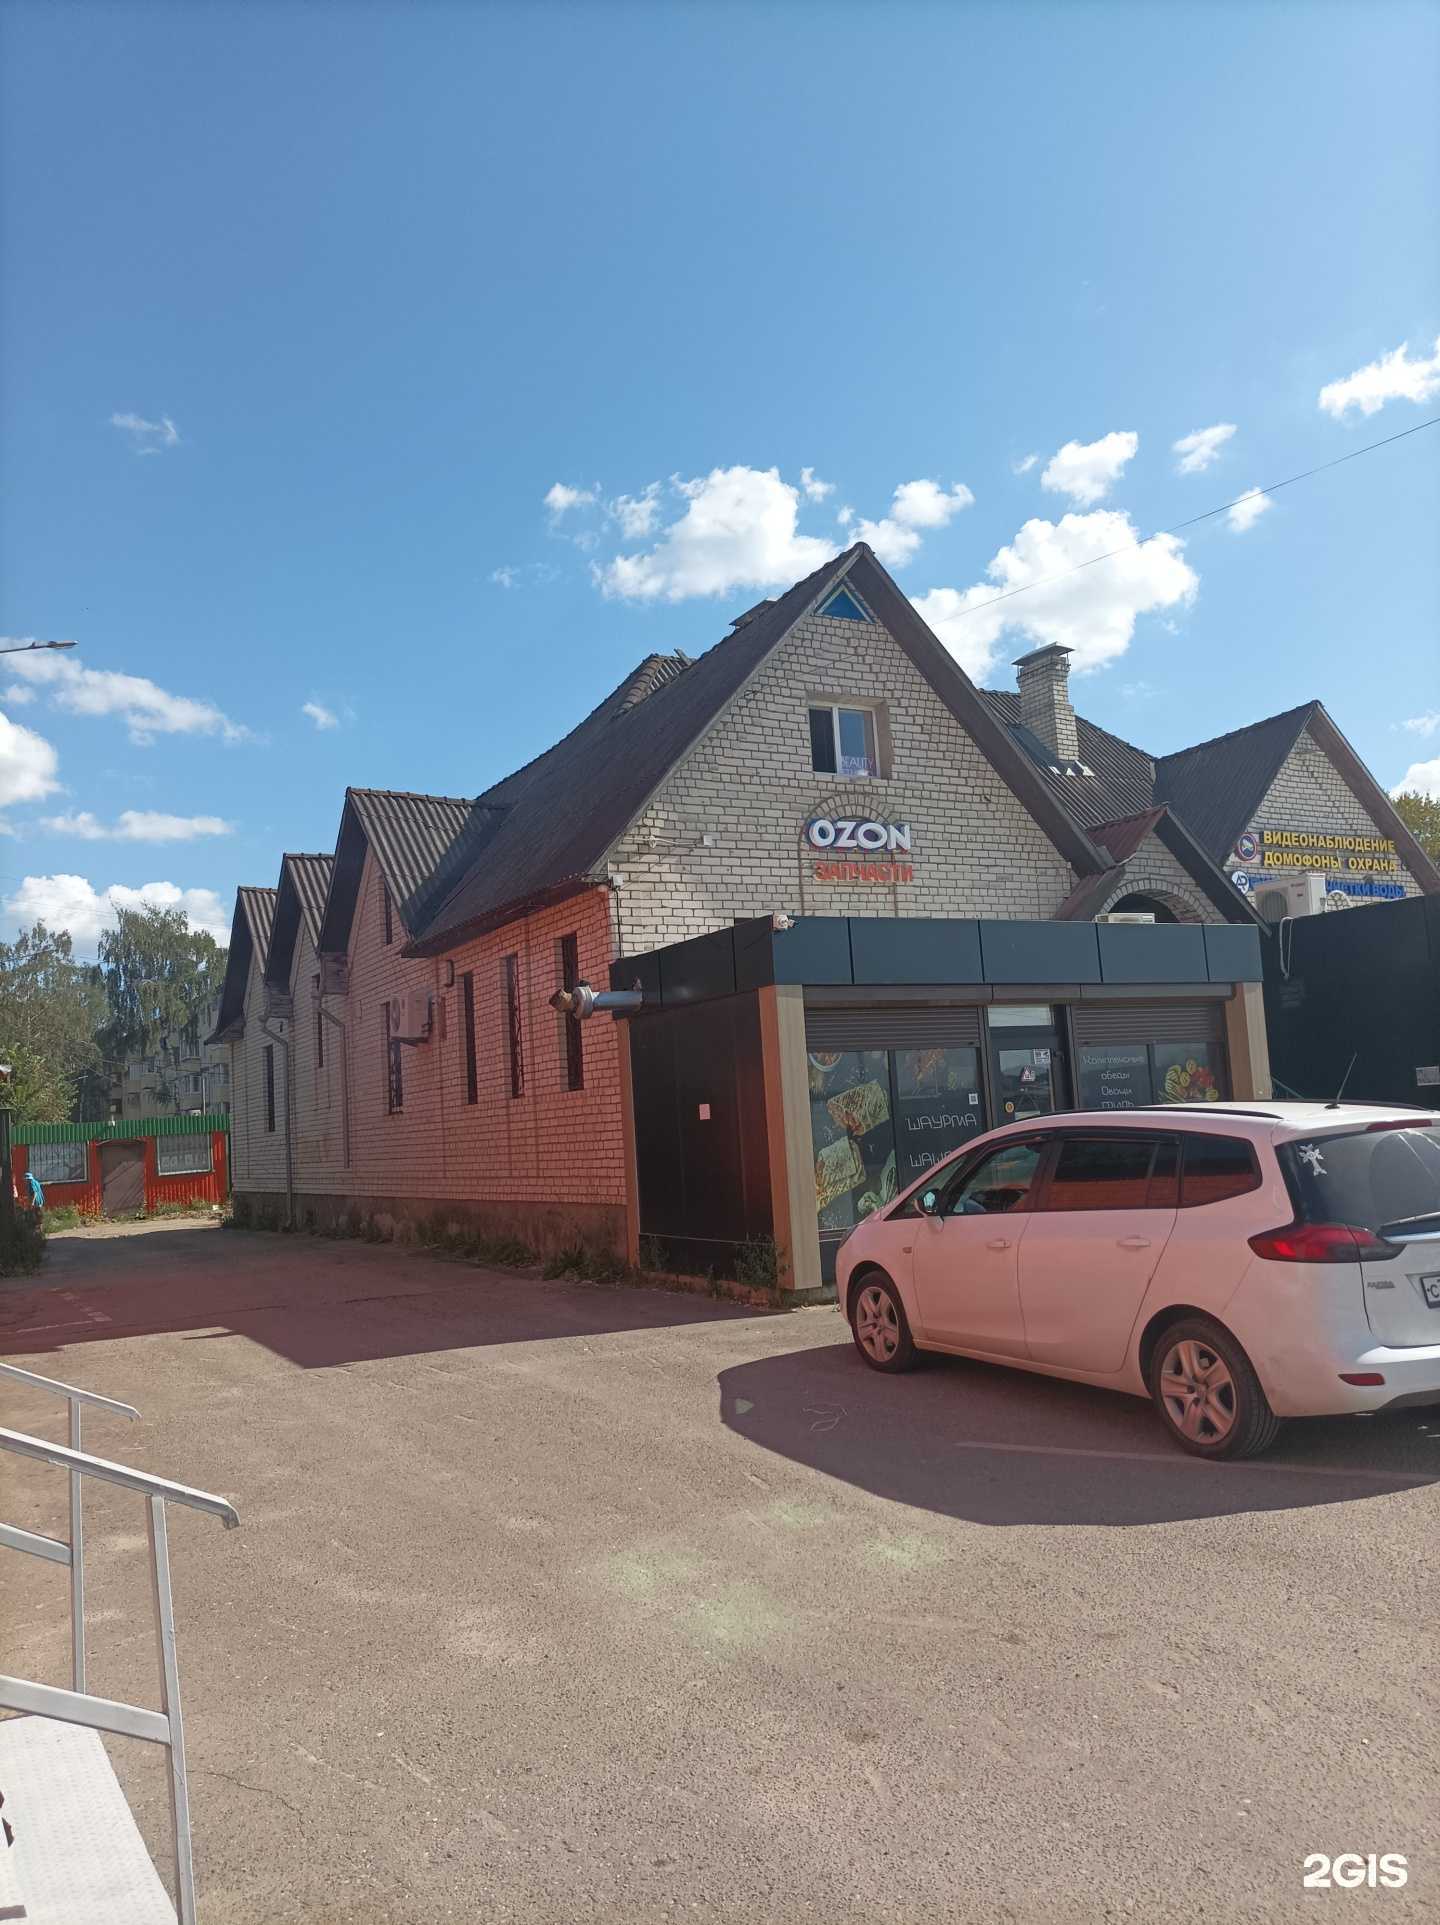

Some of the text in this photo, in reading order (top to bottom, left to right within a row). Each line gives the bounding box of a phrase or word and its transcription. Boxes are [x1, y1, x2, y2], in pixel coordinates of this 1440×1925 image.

[809, 819, 912, 849] OZON
[1263, 831, 1396, 853] ВИДЕОНАБЛЮДЕНИЕ
[815, 861, 913, 882] ЗАПЧАСТИ
[1263, 852, 1397, 872] ДОМОФОНЫ ОХРАНА
[1373, 884, 1407, 899] ВОДЫ
[906, 1113, 977, 1131] ШАУРМА
